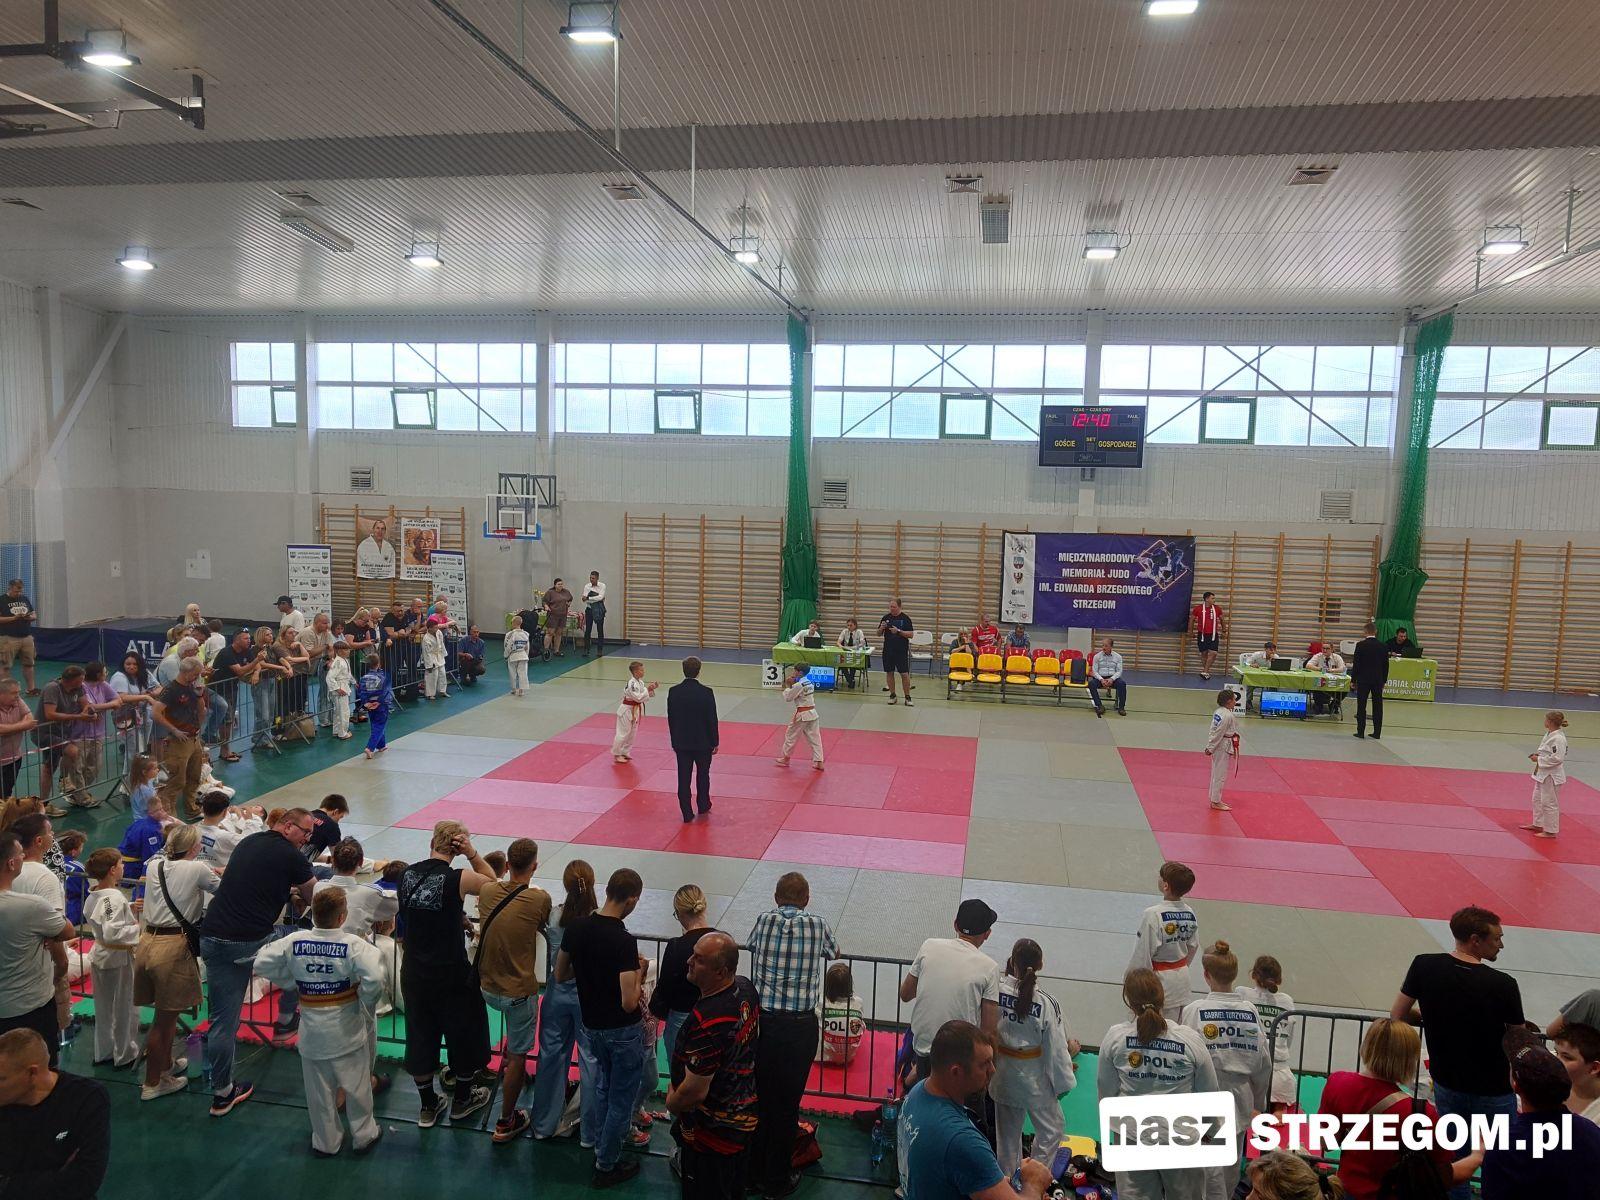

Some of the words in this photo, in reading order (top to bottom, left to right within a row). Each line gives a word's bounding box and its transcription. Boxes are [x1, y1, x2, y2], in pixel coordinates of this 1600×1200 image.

[1072, 413, 1112, 427] 12:40
[1054, 439, 1076, 447] GOŚCIE
[1058, 552, 1135, 563] MIĘDZYNARODOWY
[1062, 568, 1105, 578] MEMORIAŁ
[1107, 569, 1130, 578] JUDO
[1039, 582, 1051, 592] IM.
[1054, 583, 1095, 594] EDWARDA
[1096, 584, 1152, 596] BRZEGOWEGO
[1073, 600, 1116, 609] STRZEGOM
[126, 640, 170, 659] ATLA
[767, 666, 778, 680] 3
[306, 964, 334, 974] CZE
[1003, 1010, 1024, 1024] POL
[824, 1021, 845, 1031] POL
[1219, 1026, 1244, 1037] POL
[1143, 1056, 1172, 1068] POL
